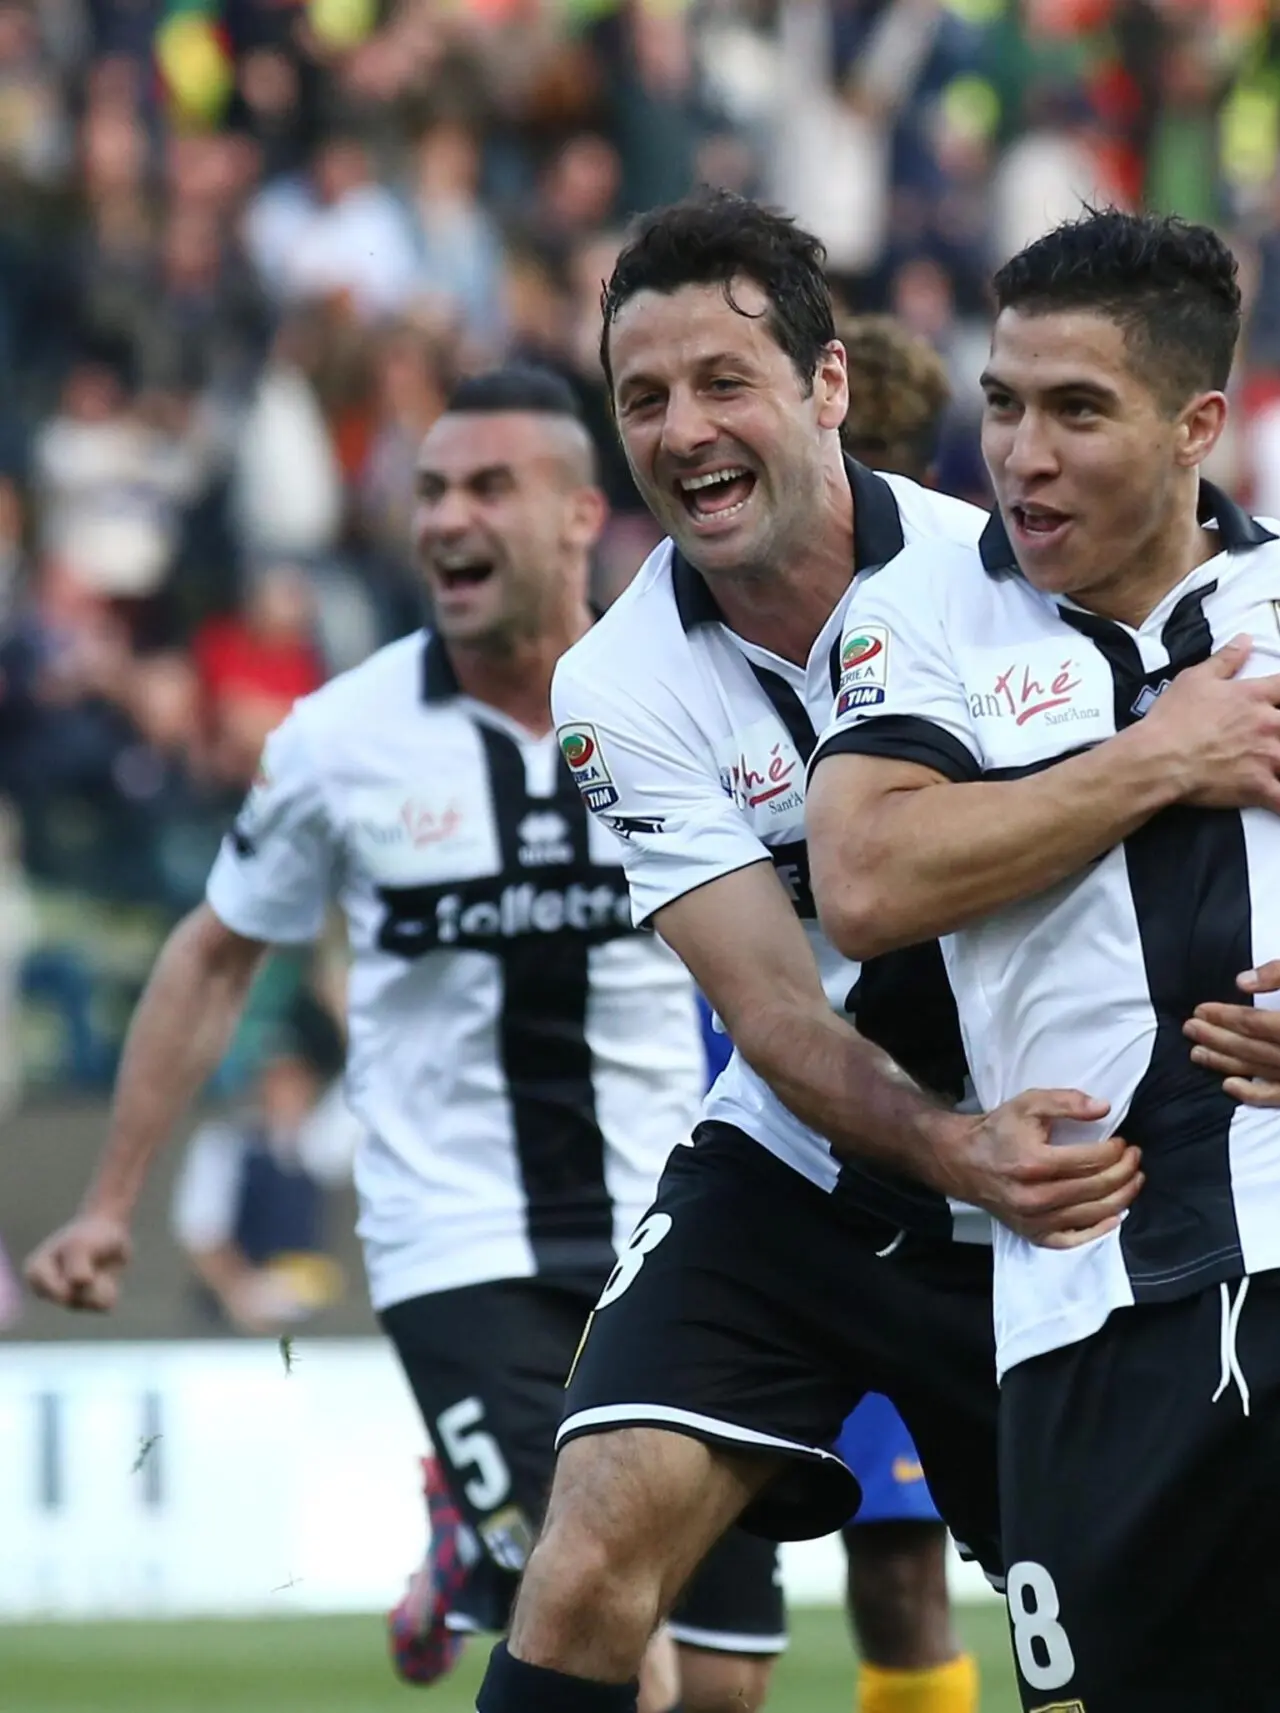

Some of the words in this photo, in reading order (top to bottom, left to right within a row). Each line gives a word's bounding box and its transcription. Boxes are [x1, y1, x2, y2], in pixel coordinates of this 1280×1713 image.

[847, 688, 879, 706] TIM
[587, 788, 612, 808] TIM
[436, 1396, 511, 1511] 5
[1007, 1560, 1076, 1691] 8
